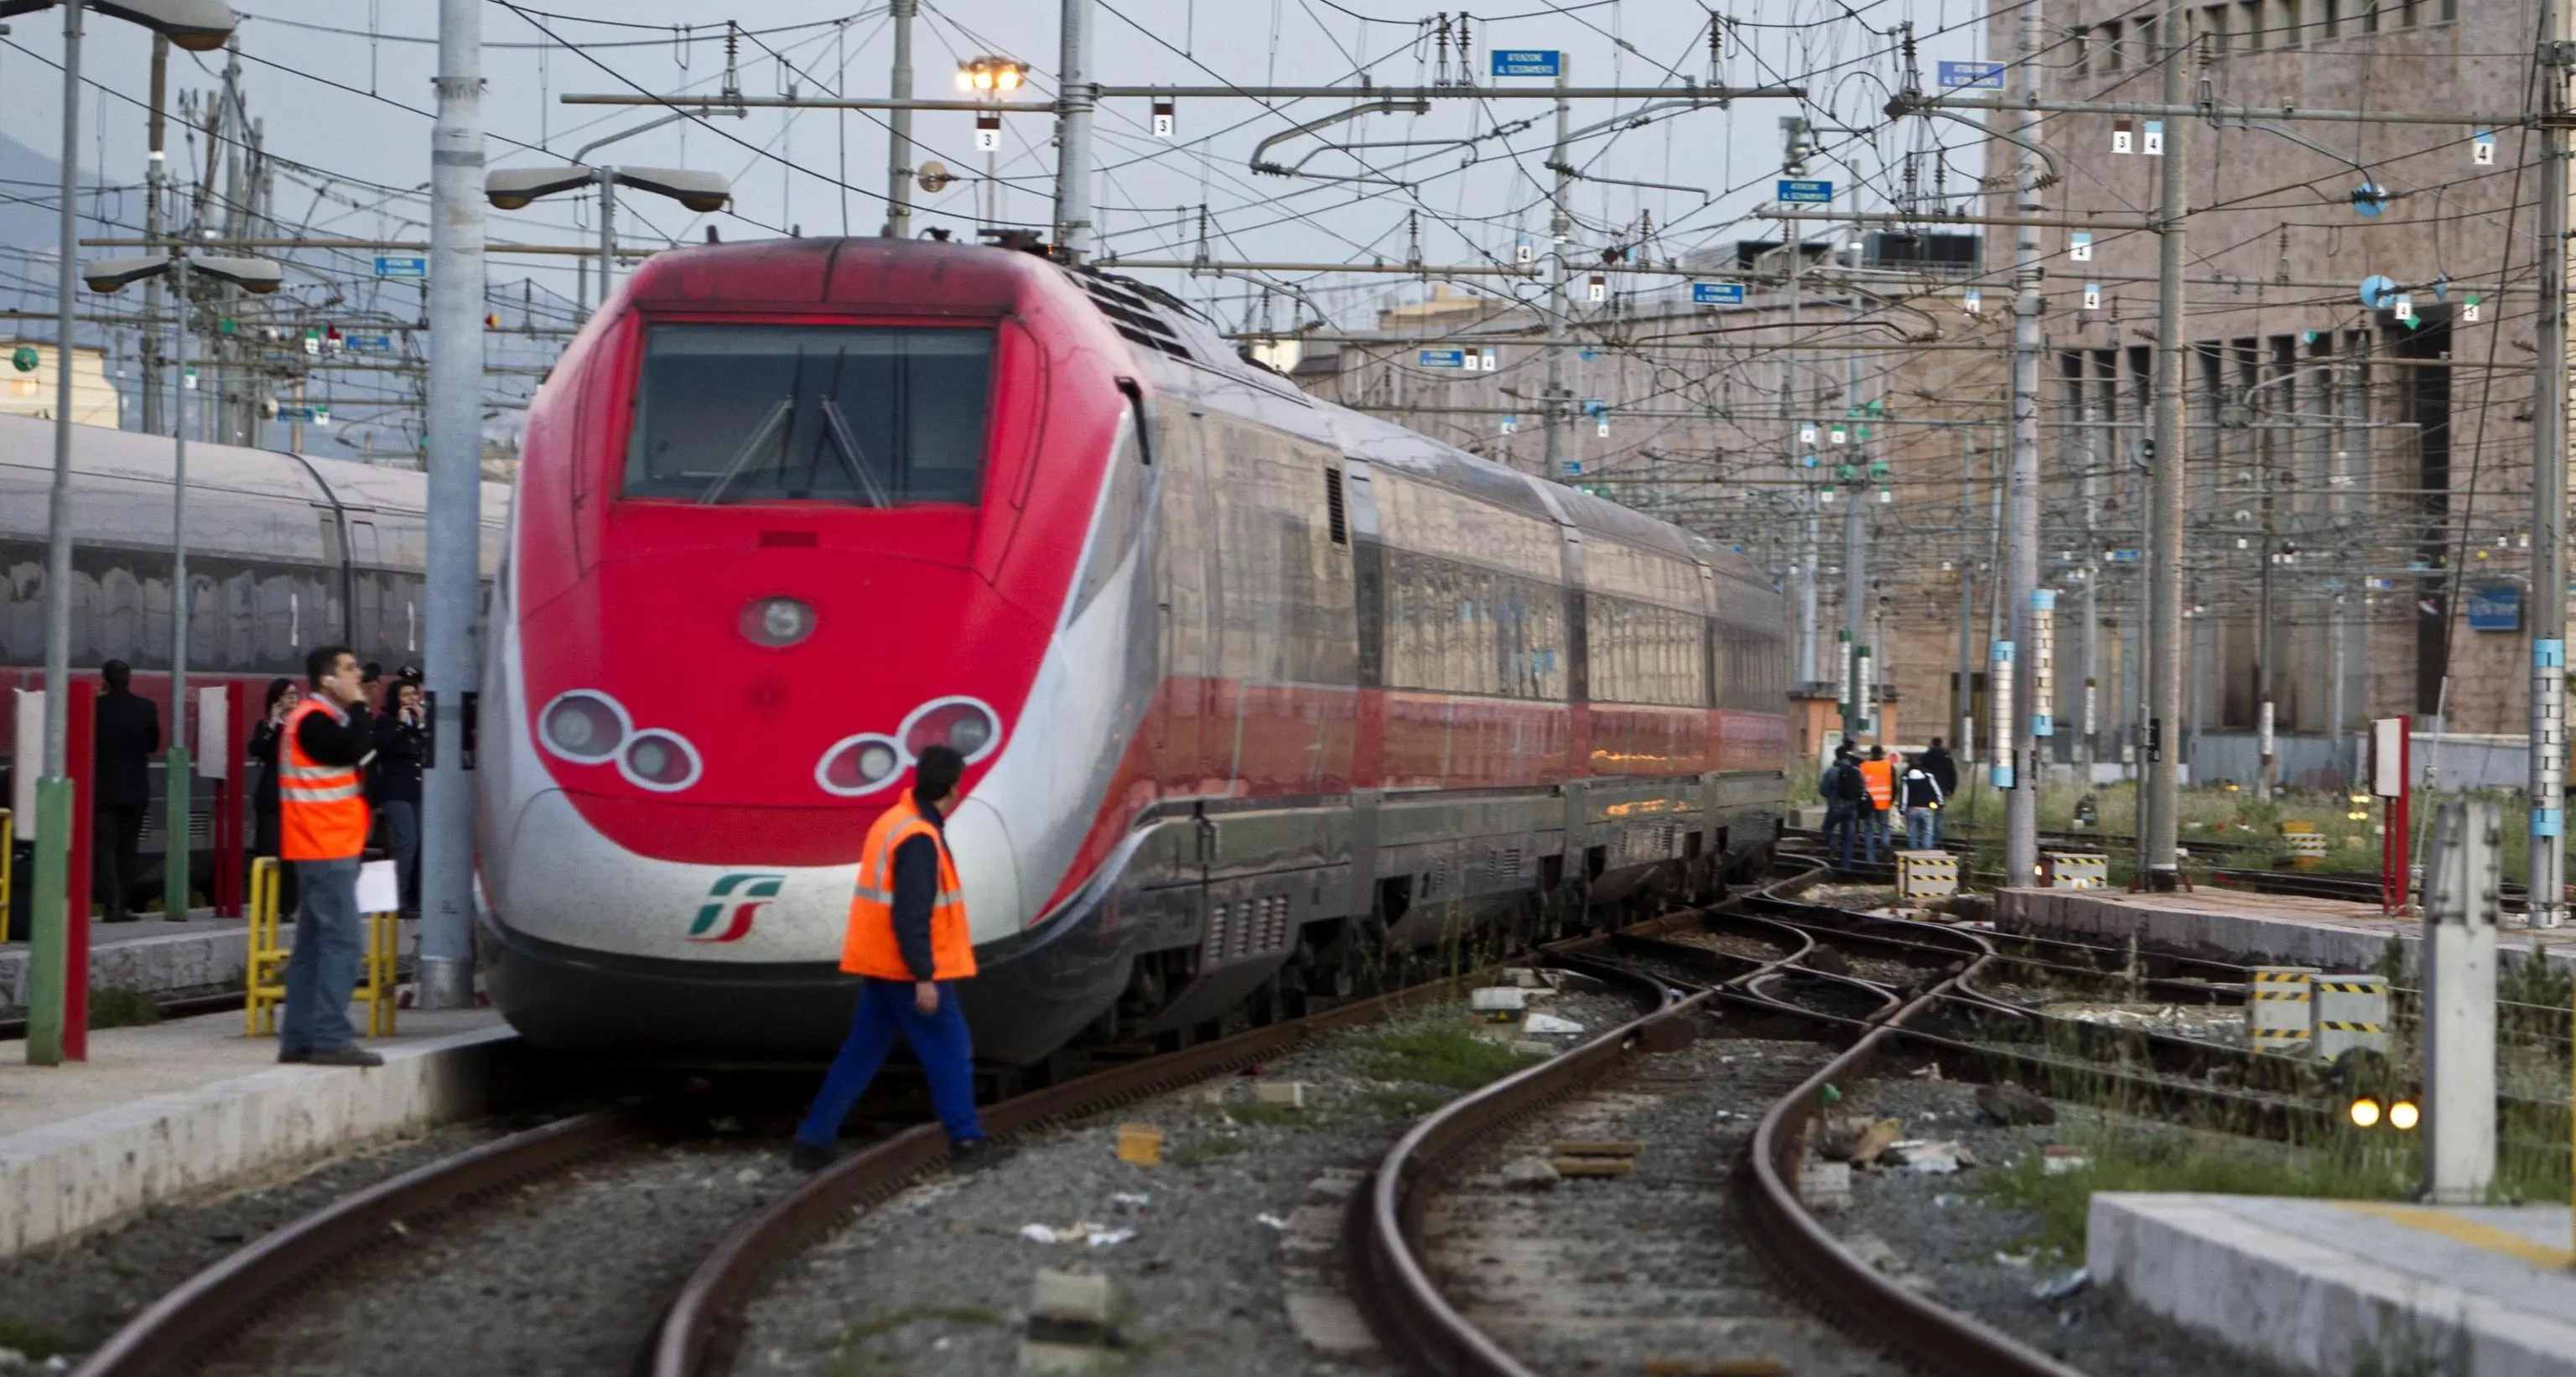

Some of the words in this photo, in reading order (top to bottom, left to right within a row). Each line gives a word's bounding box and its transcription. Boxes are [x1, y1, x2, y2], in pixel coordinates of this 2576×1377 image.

[1160, 119, 1167, 133] 3
[984, 133, 992, 147] 3
[2119, 136, 2126, 148] 3
[2149, 138, 2157, 149] 4
[2478, 145, 2488, 160] 4
[1521, 248, 1528, 260] 4
[2087, 294, 2095, 306] 4
